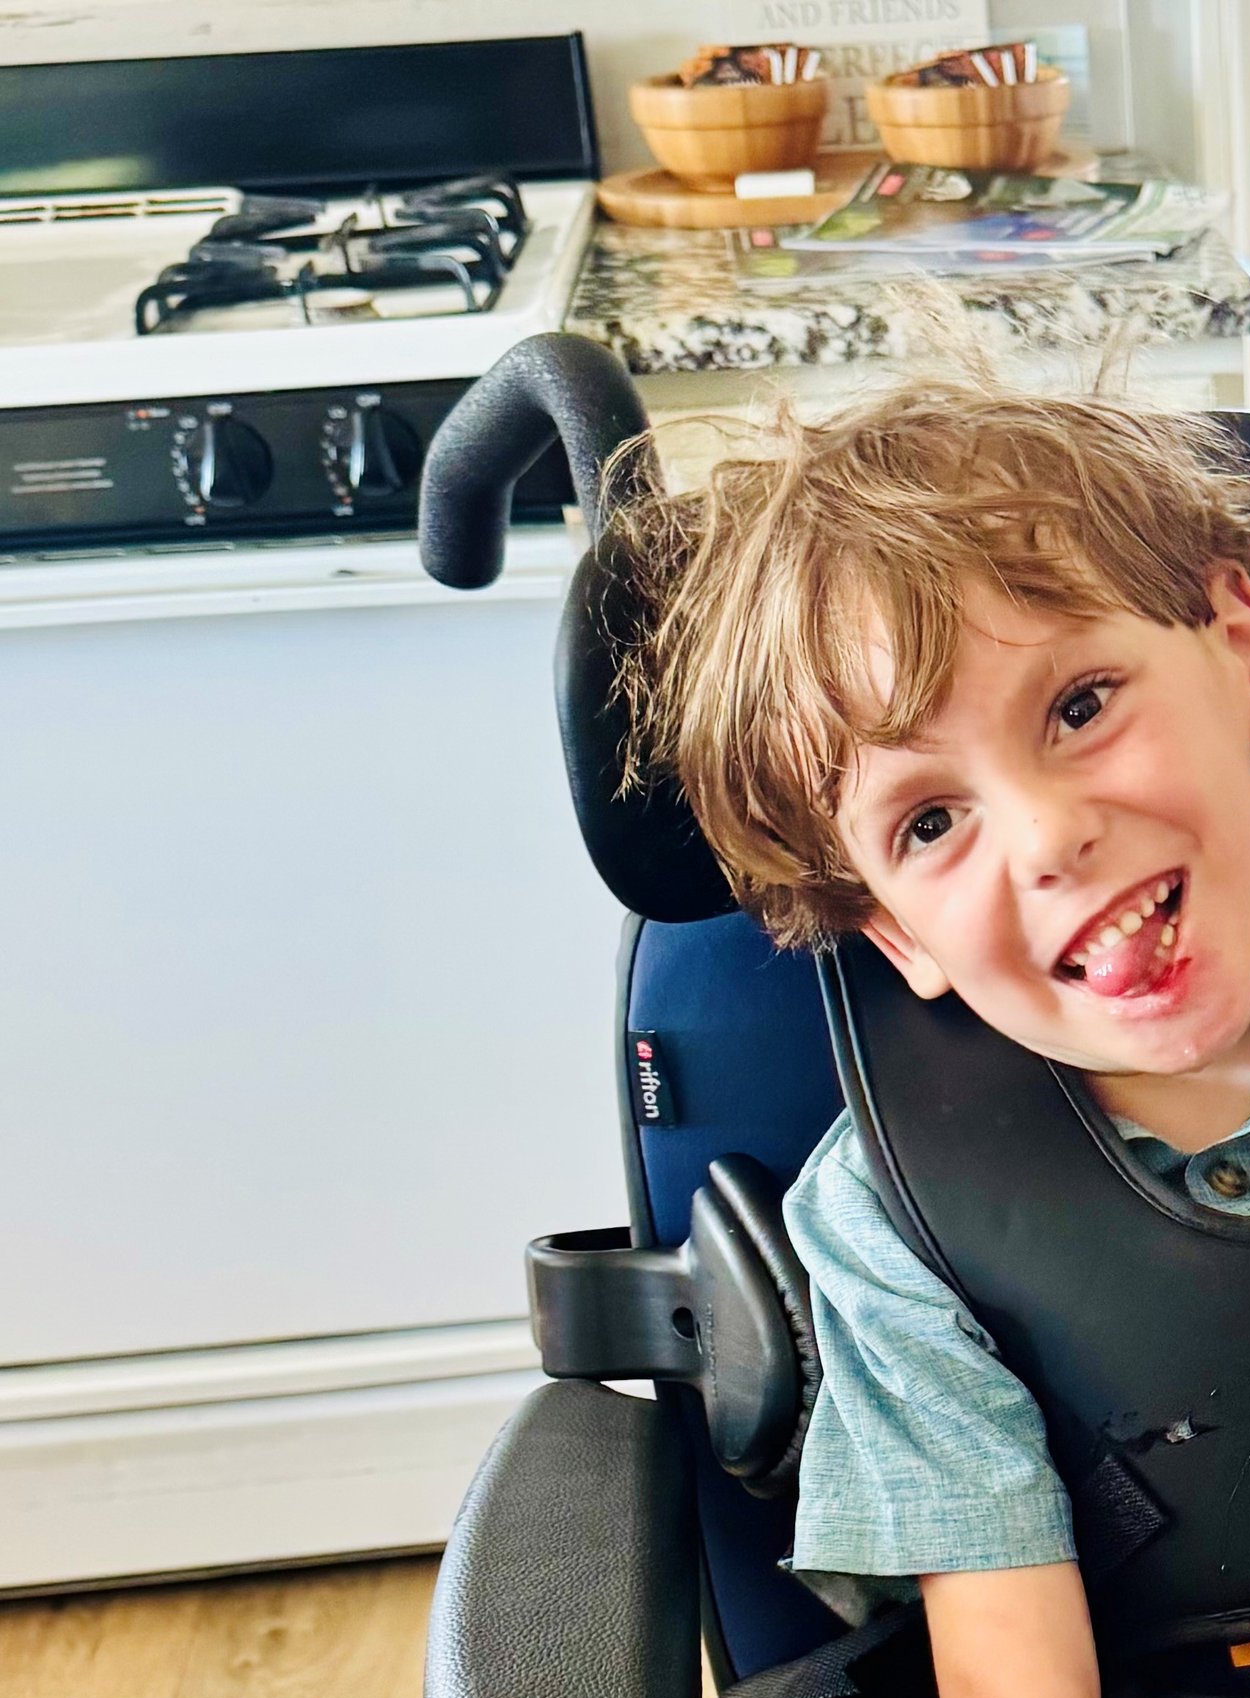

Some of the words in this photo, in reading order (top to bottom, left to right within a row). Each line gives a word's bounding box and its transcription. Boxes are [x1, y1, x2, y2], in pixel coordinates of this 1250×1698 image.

[757, 1, 822, 30] AND
[829, 0, 961, 26] FRIENDS
[638, 1061, 661, 1118] rifton
